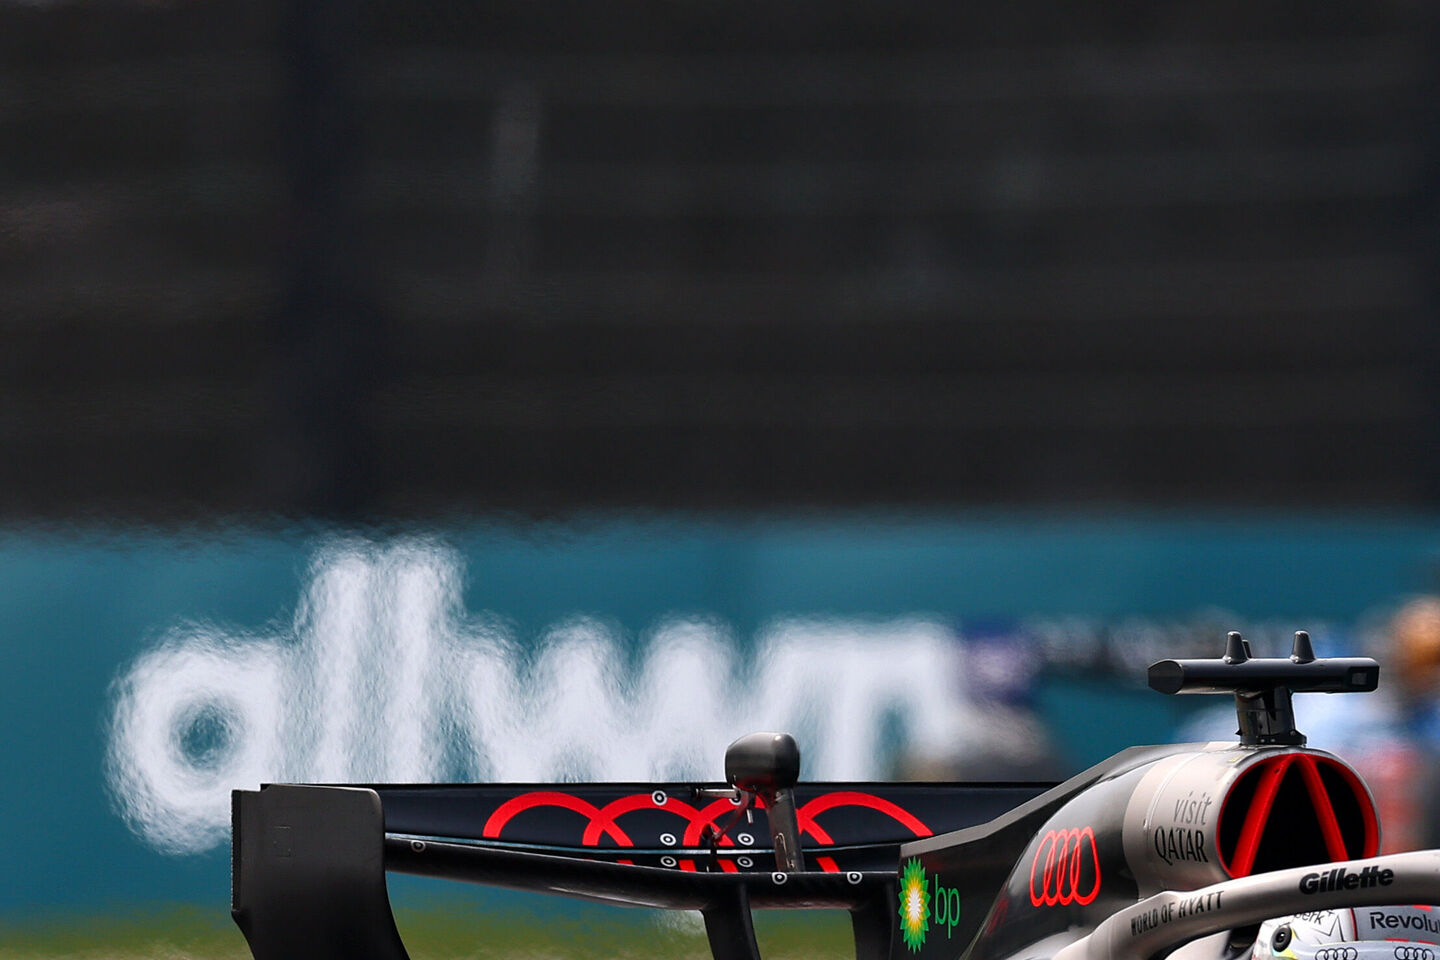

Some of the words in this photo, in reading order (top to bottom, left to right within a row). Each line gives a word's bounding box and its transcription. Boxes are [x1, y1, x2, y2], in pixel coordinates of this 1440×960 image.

[1174, 791, 1212, 826] visit
[1154, 827, 1209, 866] QATAR
[1300, 865, 1394, 896] Gillette
[935, 874, 961, 939] bp
[1131, 909, 1158, 937] WORLD
[1161, 903, 1175, 923] OF
[1179, 890, 1224, 918] HYATT
